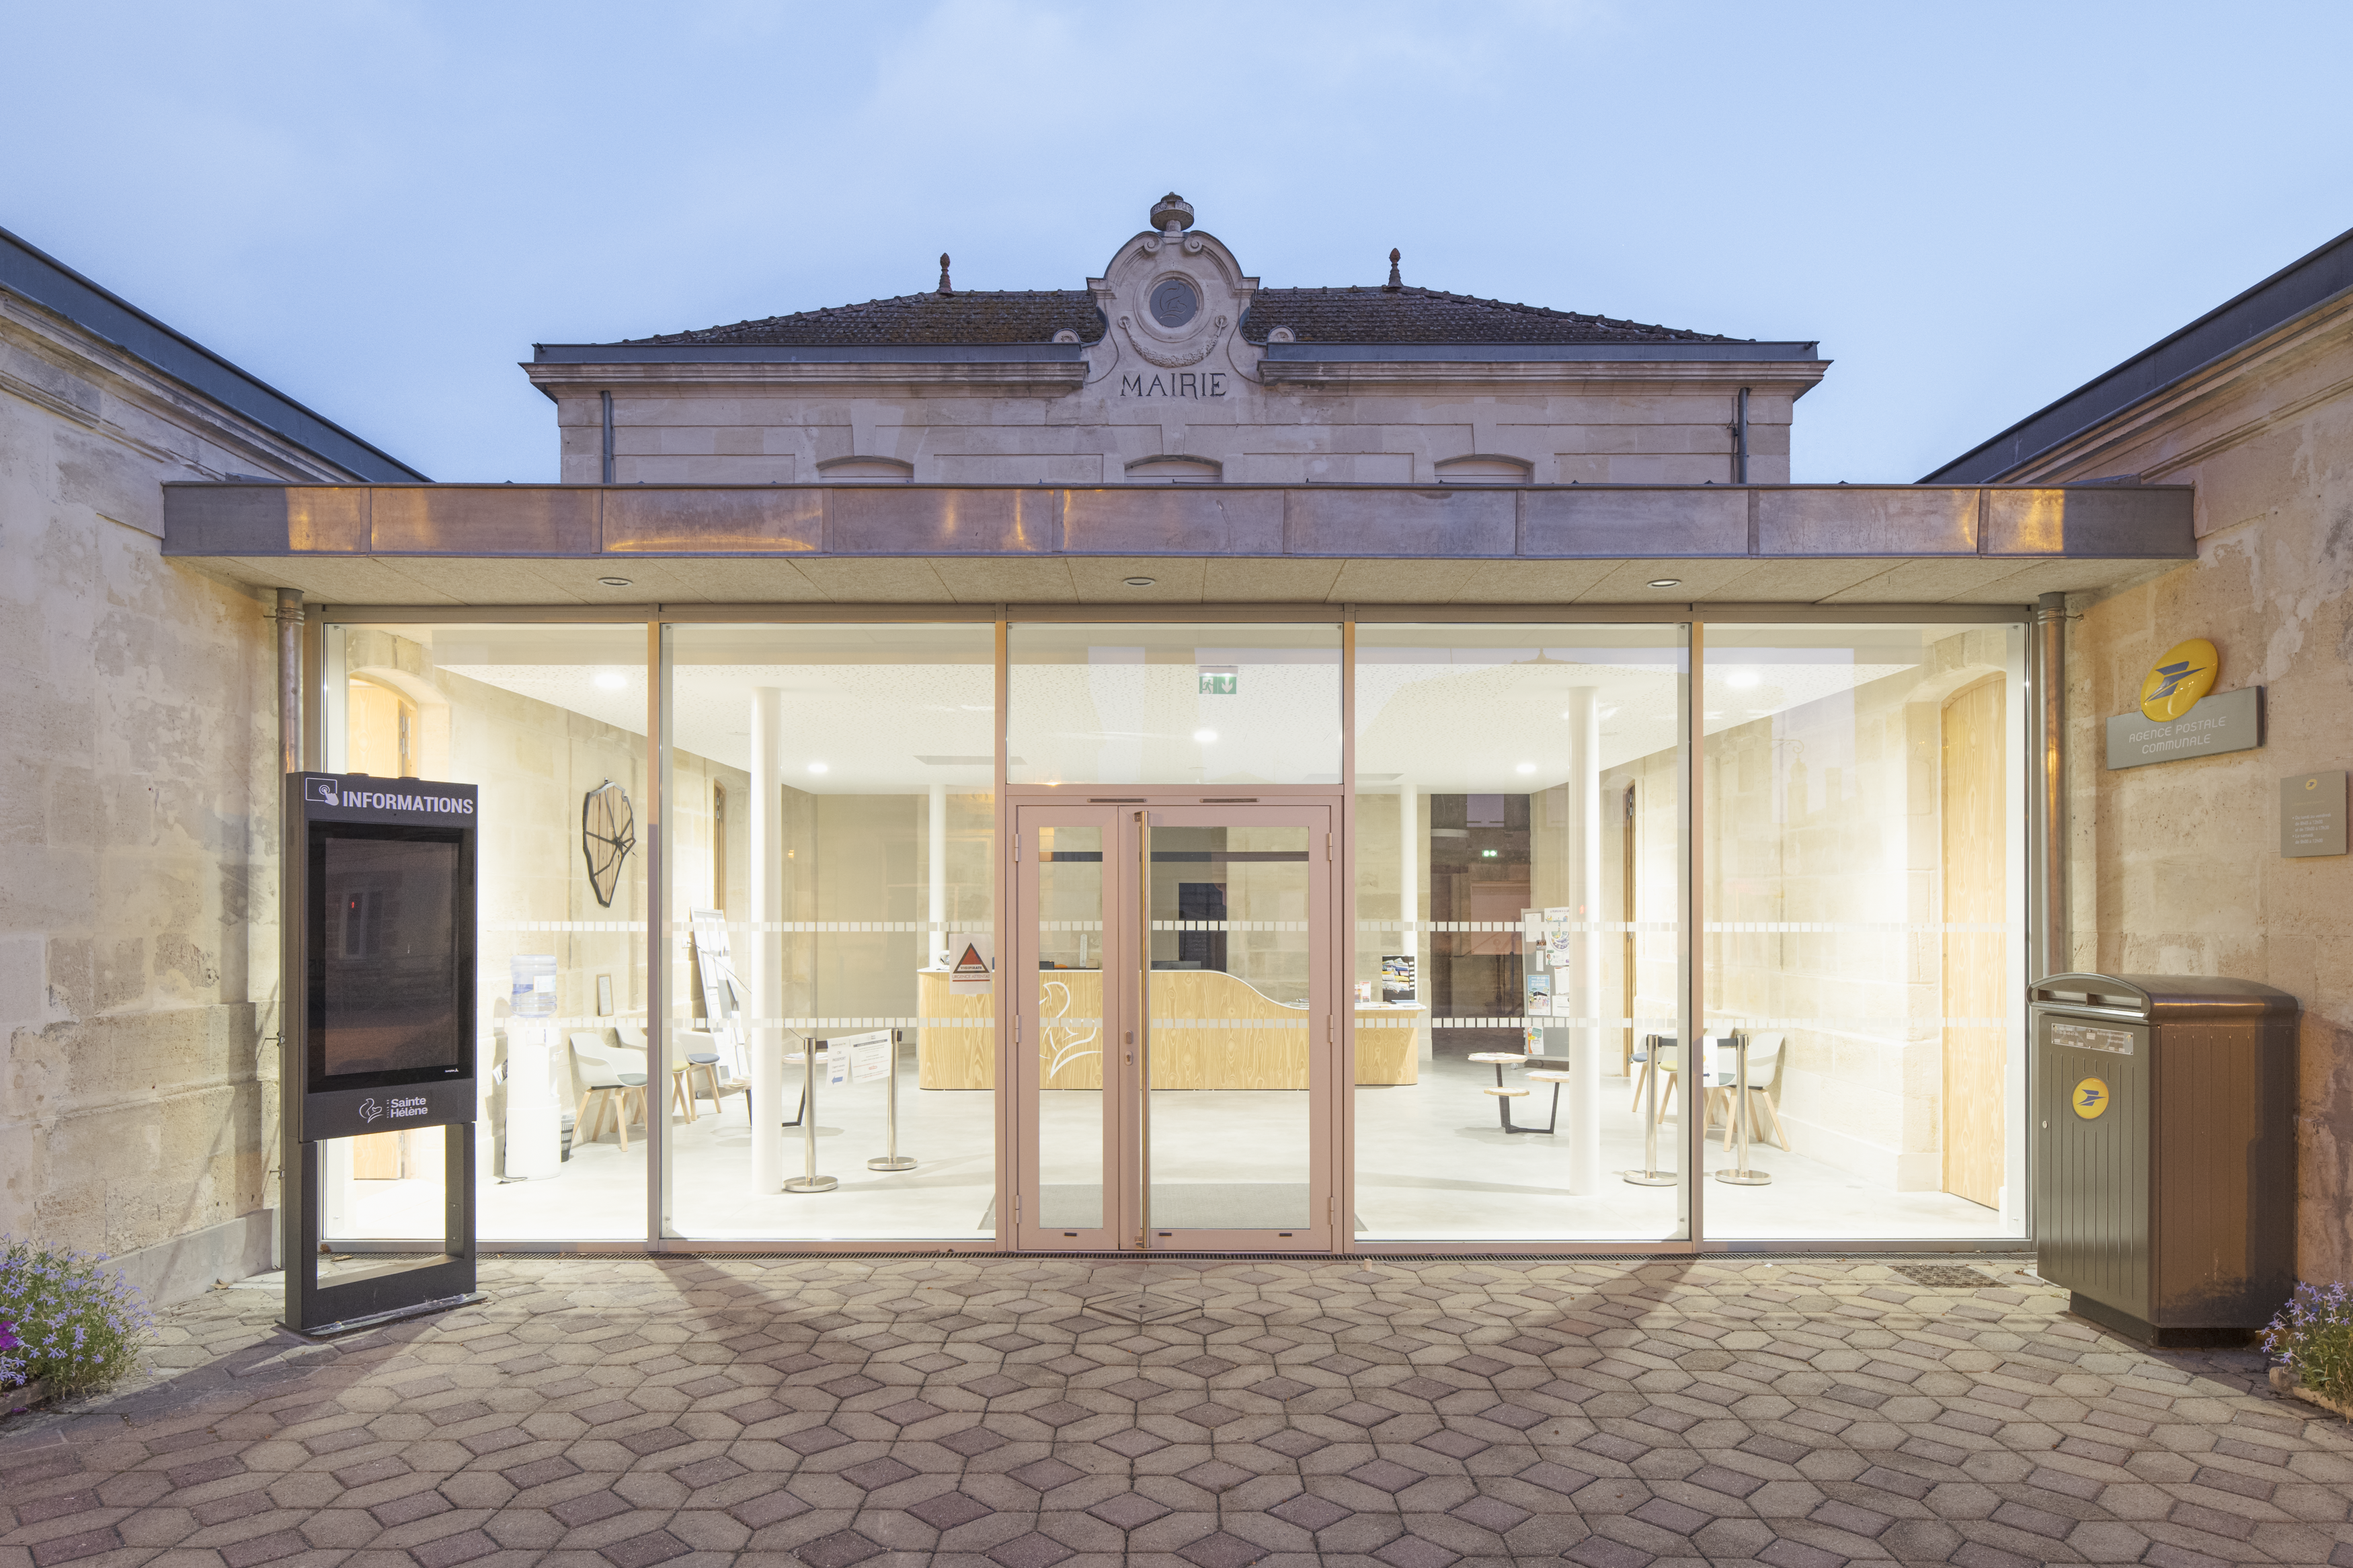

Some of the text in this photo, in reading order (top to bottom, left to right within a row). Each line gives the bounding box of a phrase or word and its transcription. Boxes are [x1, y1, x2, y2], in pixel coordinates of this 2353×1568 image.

[1120, 372, 1227, 400] MAIRIE
[2128, 716, 2227, 743] AGENCE POSTALE
[2142, 733, 2211, 754] COMMUNALE
[343, 790, 473, 814] INFORMATIONS
[390, 1106, 428, 1118] Hélène
[391, 1096, 426, 1108] Sainte
